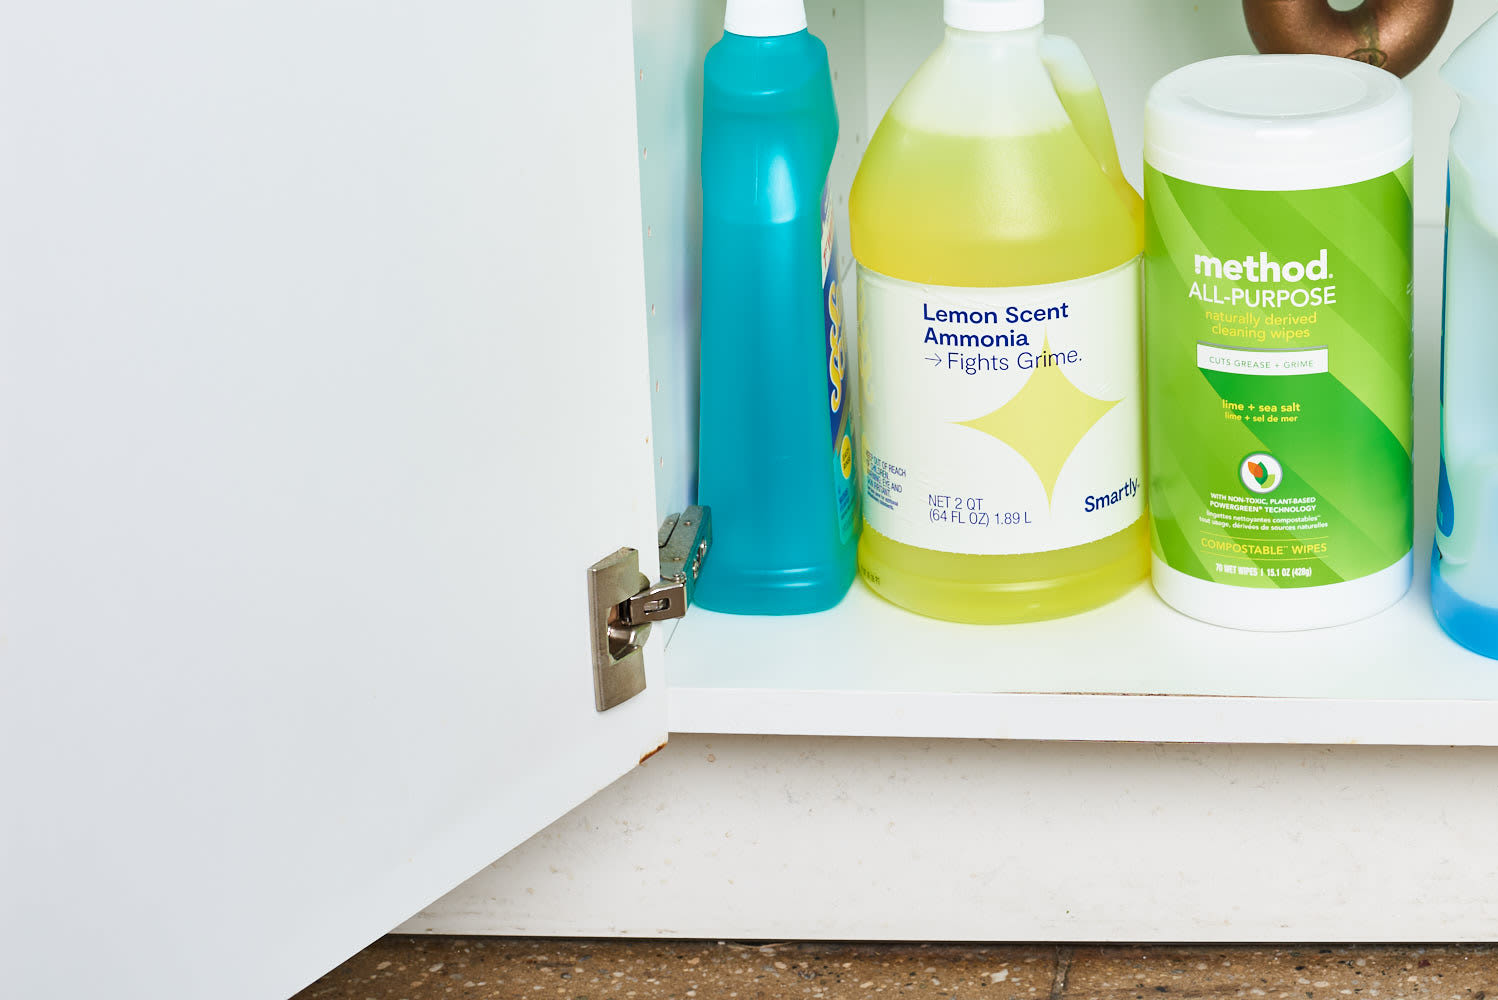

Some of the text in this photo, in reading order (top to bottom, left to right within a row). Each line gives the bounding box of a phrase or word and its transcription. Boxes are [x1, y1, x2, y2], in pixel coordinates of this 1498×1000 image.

[1189, 281, 1336, 308] ALL-PURPOSE
[923, 303, 1068, 324] Lemon Scent
[1206, 311, 1317, 328] naturally derived
[924, 327, 1029, 347] Ammonia
[1212, 324, 1310, 342] cleaning wipes
[948, 350, 1082, 375] Fights Grime.
[1209, 356, 1230, 366] CUTS
[1234, 360, 1270, 368] GREASE
[1284, 360, 1313, 368] GRIME
[1222, 399, 1244, 411] lime
[1281, 402, 1300, 412] salt
[1225, 412, 1242, 420] lime
[929, 495, 983, 510] NET 2 QT
[1228, 496, 1268, 505] NON-TOXIC,
[1265, 505, 1316, 513] TECHNOLOGY
[929, 509, 1031, 527] (64 FL OZ) 1.89 L
[1232, 521, 1259, 530] dérivées
[1297, 522, 1328, 530] naturelles
[1292, 543, 1327, 554] WIPES
[1224, 564, 1239, 574] WET
[1241, 566, 1257, 575] WIPES
[1282, 568, 1290, 576] OZ
